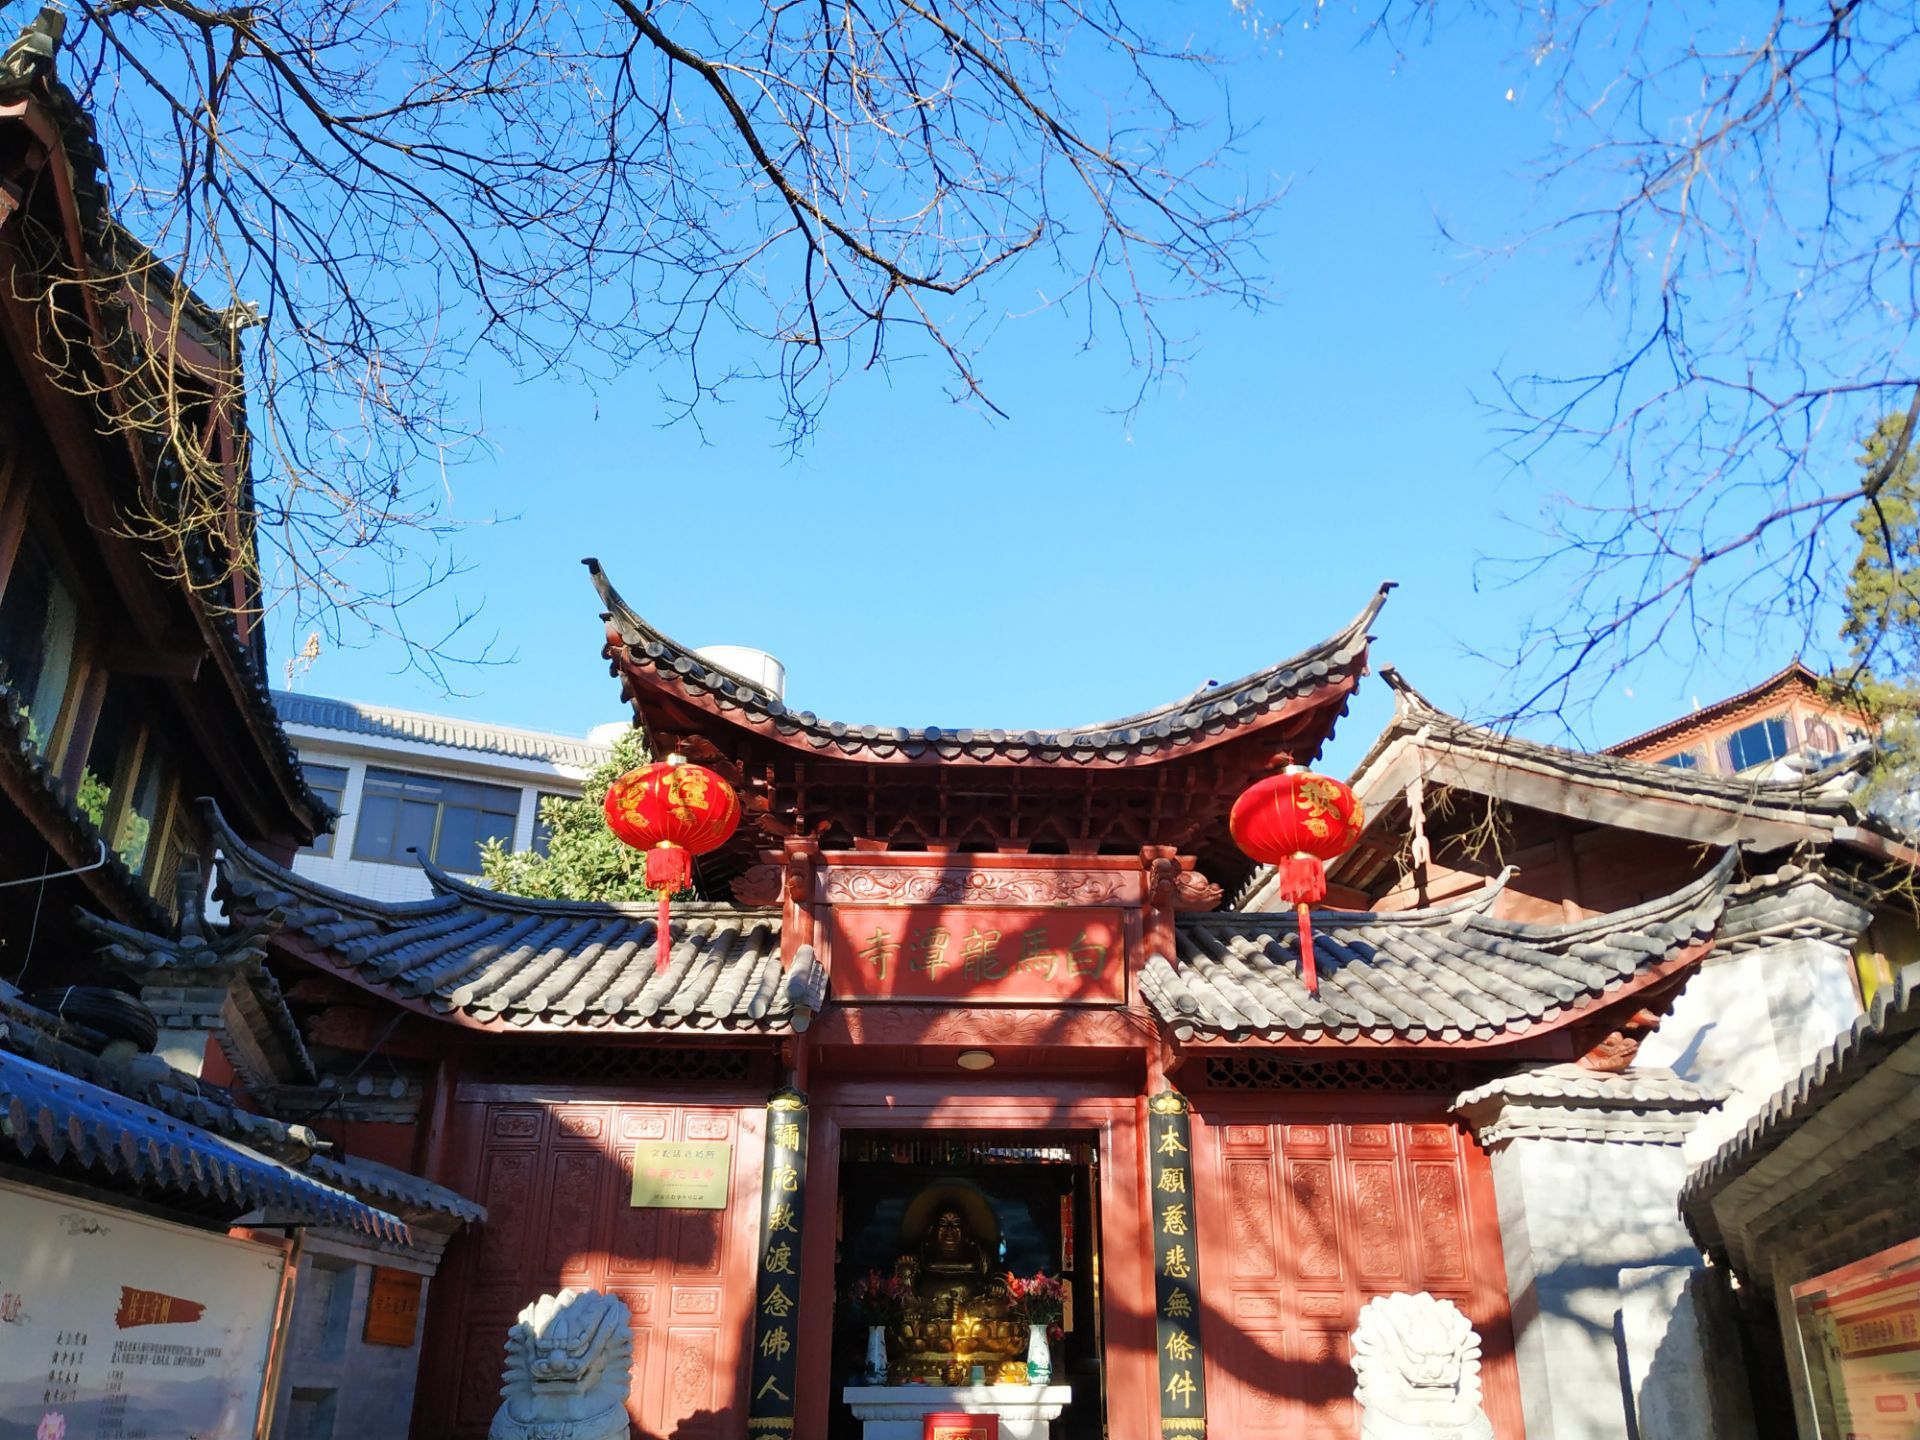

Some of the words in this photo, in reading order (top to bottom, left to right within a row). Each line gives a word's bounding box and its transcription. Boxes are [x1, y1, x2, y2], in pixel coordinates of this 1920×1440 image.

[858, 924, 1108, 983] 白馬龍潭寺
[756, 1123, 800, 1401] 彌陀救渡念佛人
[1156, 1124, 1197, 1409] 本願慈悲無條件
